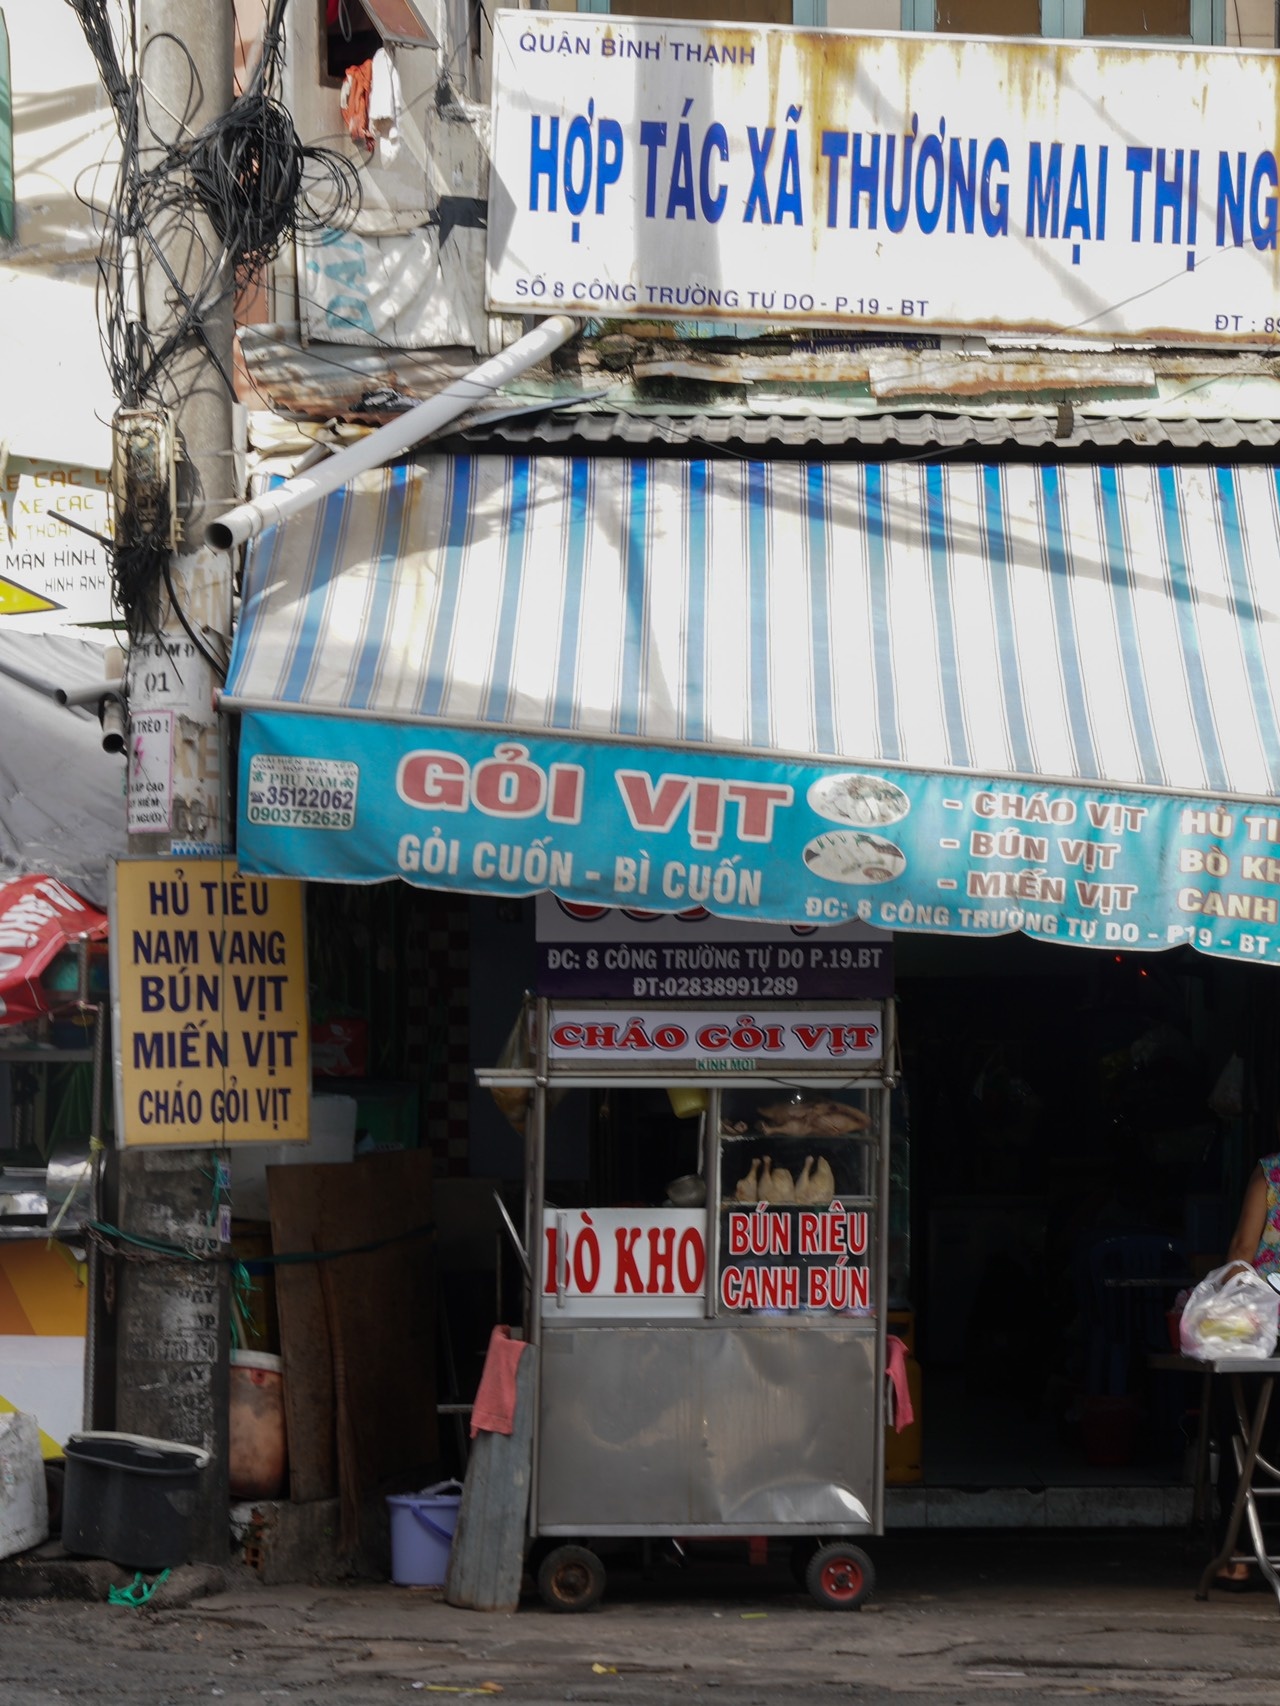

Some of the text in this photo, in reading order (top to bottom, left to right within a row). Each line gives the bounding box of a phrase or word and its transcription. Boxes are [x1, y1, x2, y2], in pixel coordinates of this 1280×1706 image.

[519, 31, 756, 68] QUẬN BÌNH THẠNH
[528, 97, 624, 243] HỢP
[639, 98, 730, 224] TÁC
[742, 105, 804, 226] XÃ
[821, 112, 1009, 237] THƯƠNG
[1025, 141, 1109, 265] MẠI
[1126, 146, 1200, 272] THỊ
[553, 282, 564, 298] 8
[572, 278, 637, 303] CÔNG
[645, 280, 739, 308] TRƯỜNG
[747, 291, 778, 314] TỰ
[784, 293, 815, 311] DO
[835, 297, 879, 315] P.19
[901, 299, 929, 317] BT
[1214, 314, 1245, 333] ĐT
[250, 806, 351, 826] 0903752628
[266, 786, 354, 811] 35122062
[397, 742, 795, 851] GỎI VỊT
[973, 790, 1148, 835] CHÁO VỊT
[397, 827, 762, 906] GỎI CUỐN BÌ CUỐN
[970, 826, 1121, 872] BÚN VỊT
[1179, 846, 1230, 878] BÒ
[149, 868, 189, 915] HỦ
[1074, 880, 1138, 915] VỊT
[1177, 887, 1279, 925] CANH
[133, 929, 285, 965] NAM VANG
[857, 899, 872, 919] 8
[880, 899, 950, 927] CÔNG
[958, 905, 1058, 937] TRƯỜNG
[1066, 918, 1099, 939] TỰ
[1105, 922, 1139, 942] DO
[1239, 932, 1270, 954] BT
[587, 950, 599, 969] 8
[604, 944, 658, 970] CÔNG
[665, 945, 741, 970] TRƯỜNG
[747, 946, 773, 974] TỰ
[778, 948, 804, 969] DO
[810, 948, 883, 969] P.19.BT
[140, 967, 288, 1020] BÚN VỊT
[633, 976, 799, 997] ĐT:02838991289
[133, 1019, 298, 1076] MIẾN VỊT
[551, 1014, 878, 1057] CHÁO GỎI VỊT
[139, 1075, 291, 1130] CHÁO GỎI VỊT
[729, 1200, 869, 1256] BÚN RIÊU
[614, 1226, 706, 1294] KHO
[721, 1255, 870, 1310] CANH BÚN
